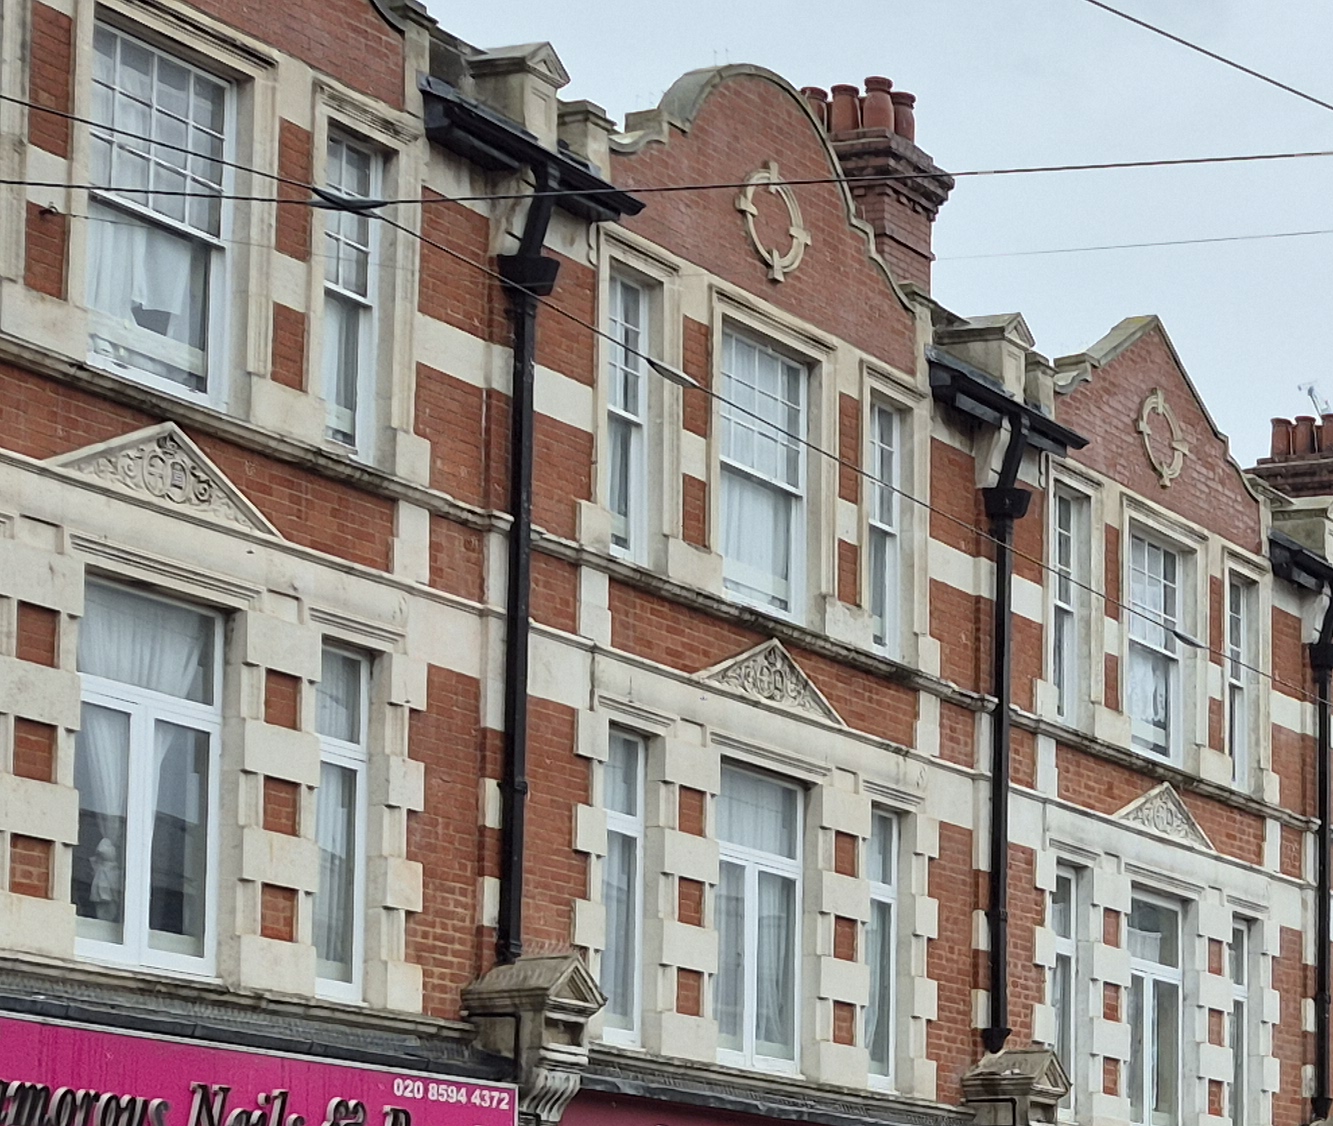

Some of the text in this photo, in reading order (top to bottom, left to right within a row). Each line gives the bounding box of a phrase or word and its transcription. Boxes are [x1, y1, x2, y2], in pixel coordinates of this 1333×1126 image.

[393, 1078, 510, 1110] 020 8594 4372
